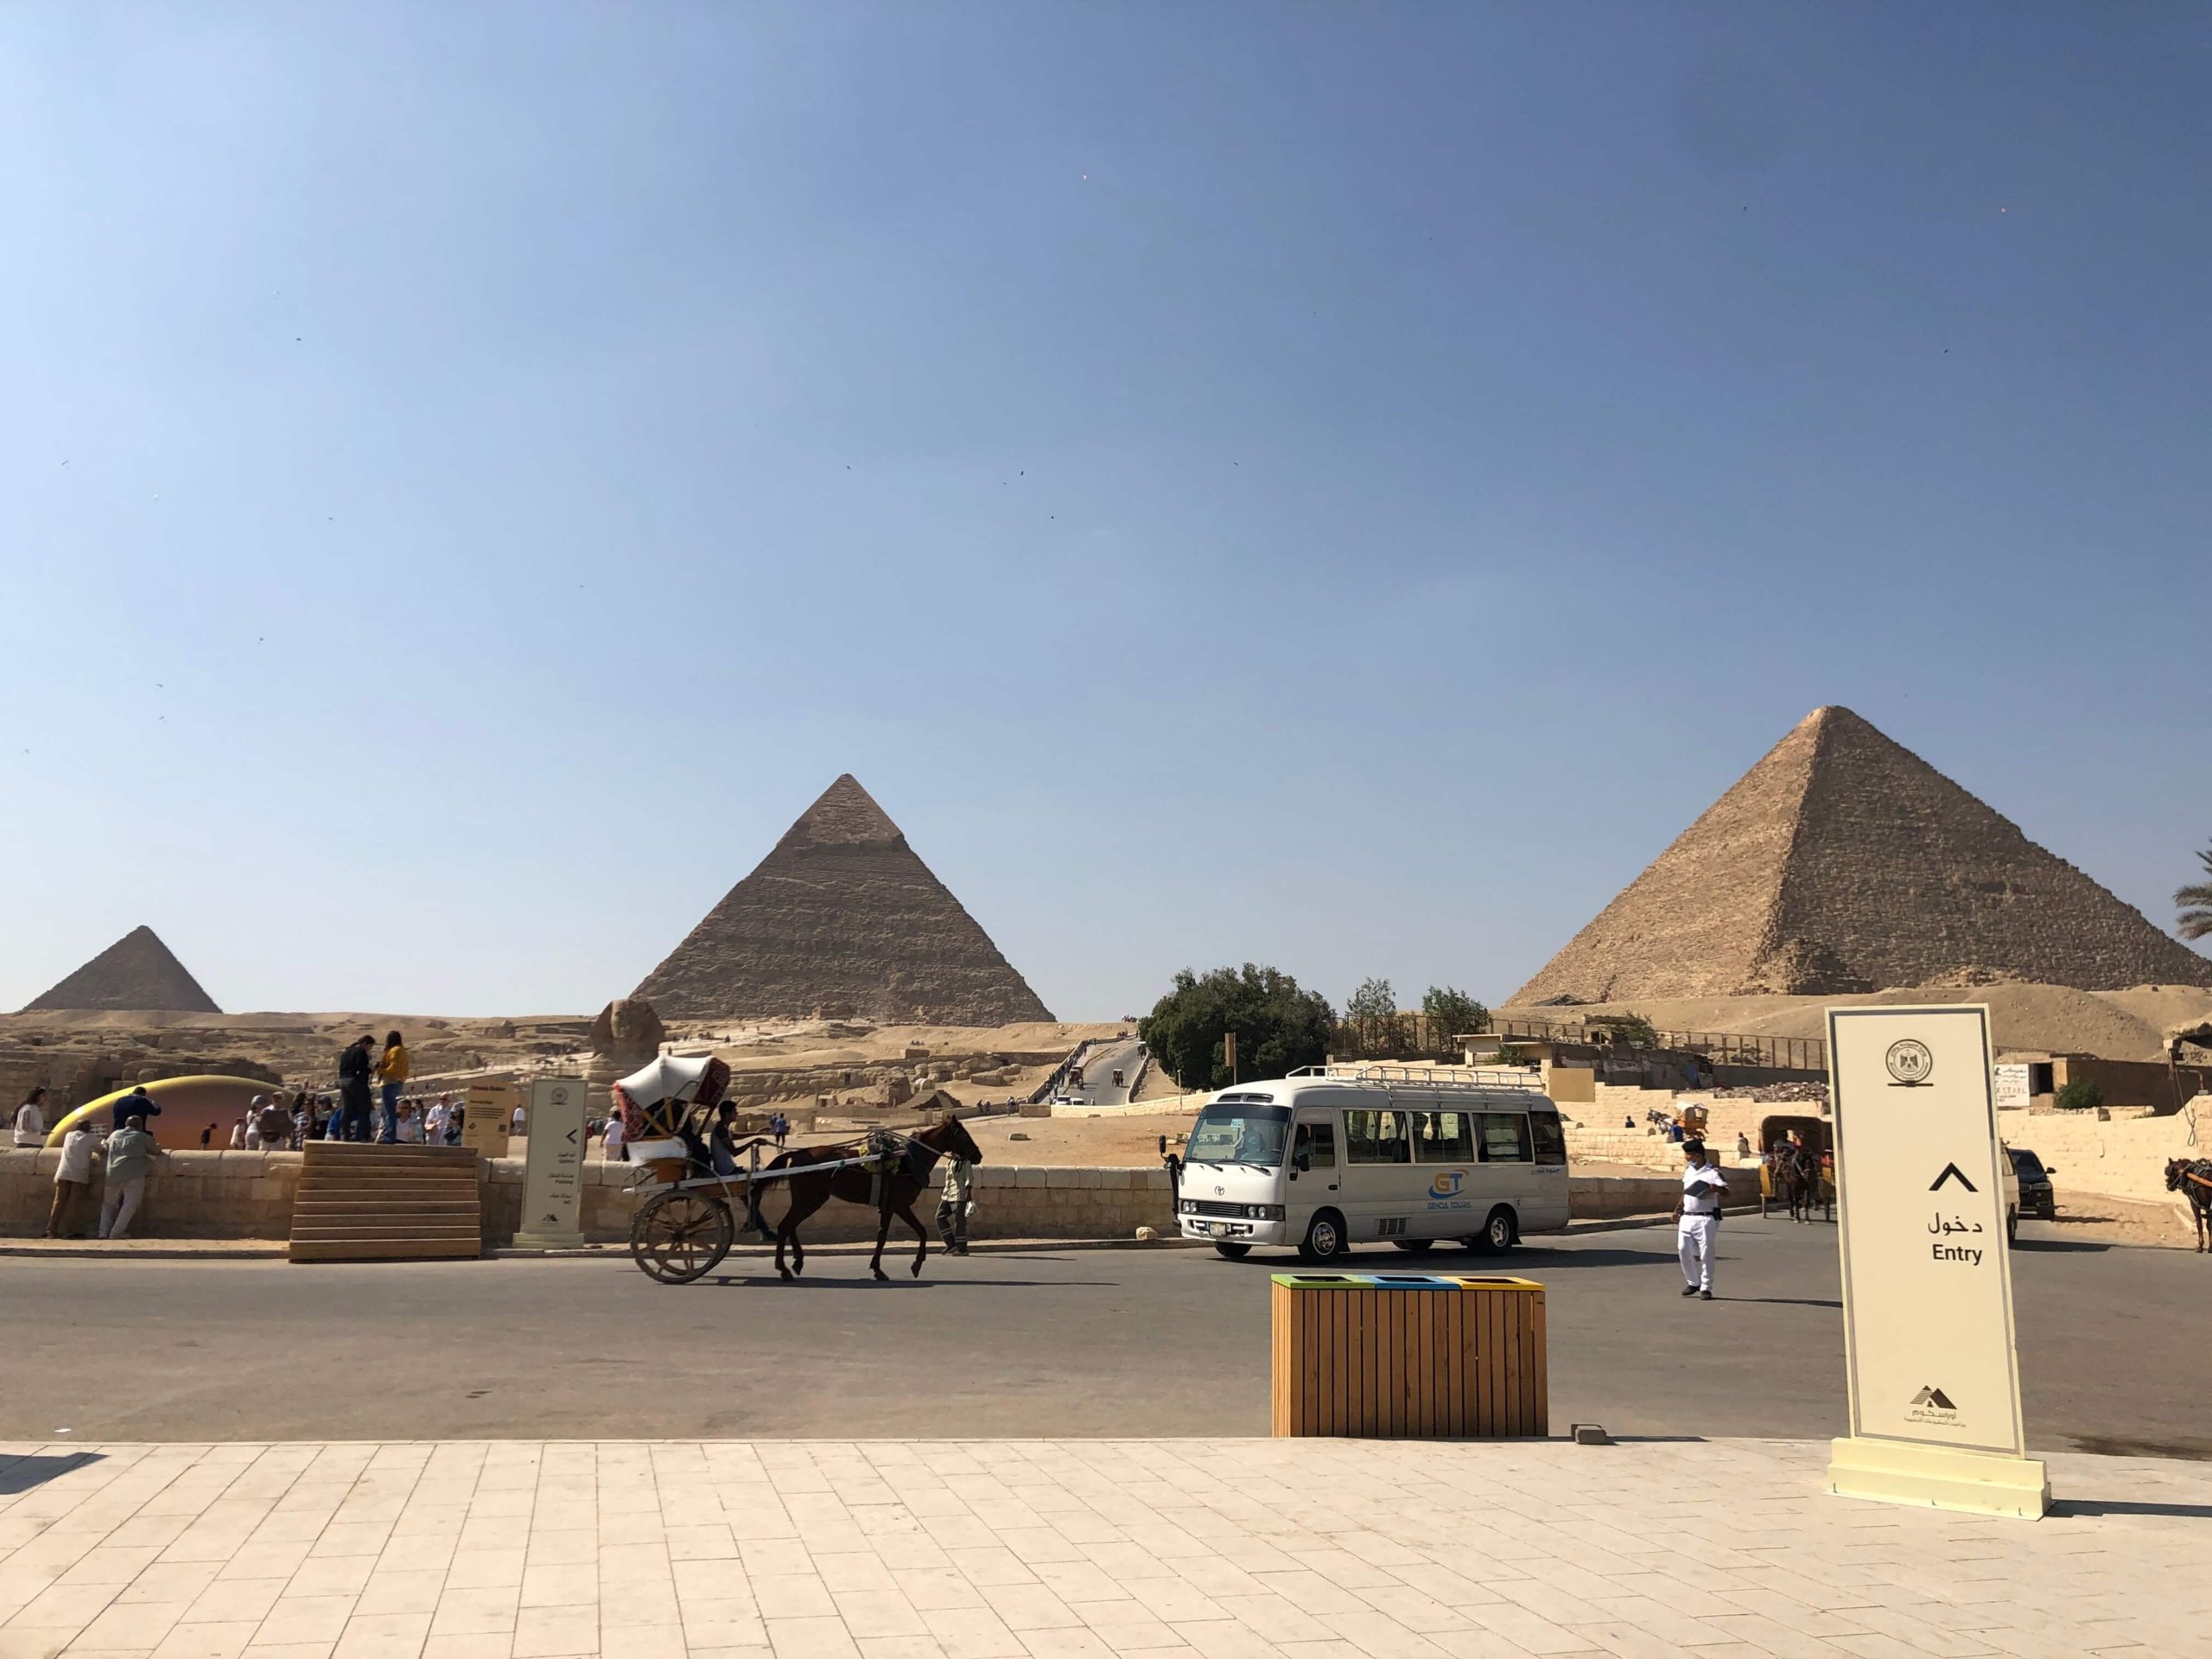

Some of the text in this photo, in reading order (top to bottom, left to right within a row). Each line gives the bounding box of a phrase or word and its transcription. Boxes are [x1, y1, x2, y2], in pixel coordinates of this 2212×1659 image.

[1434, 1173, 1464, 1192] GT
[1928, 1211, 1983, 1236] دخول
[1932, 1243, 1983, 1267] Entry
